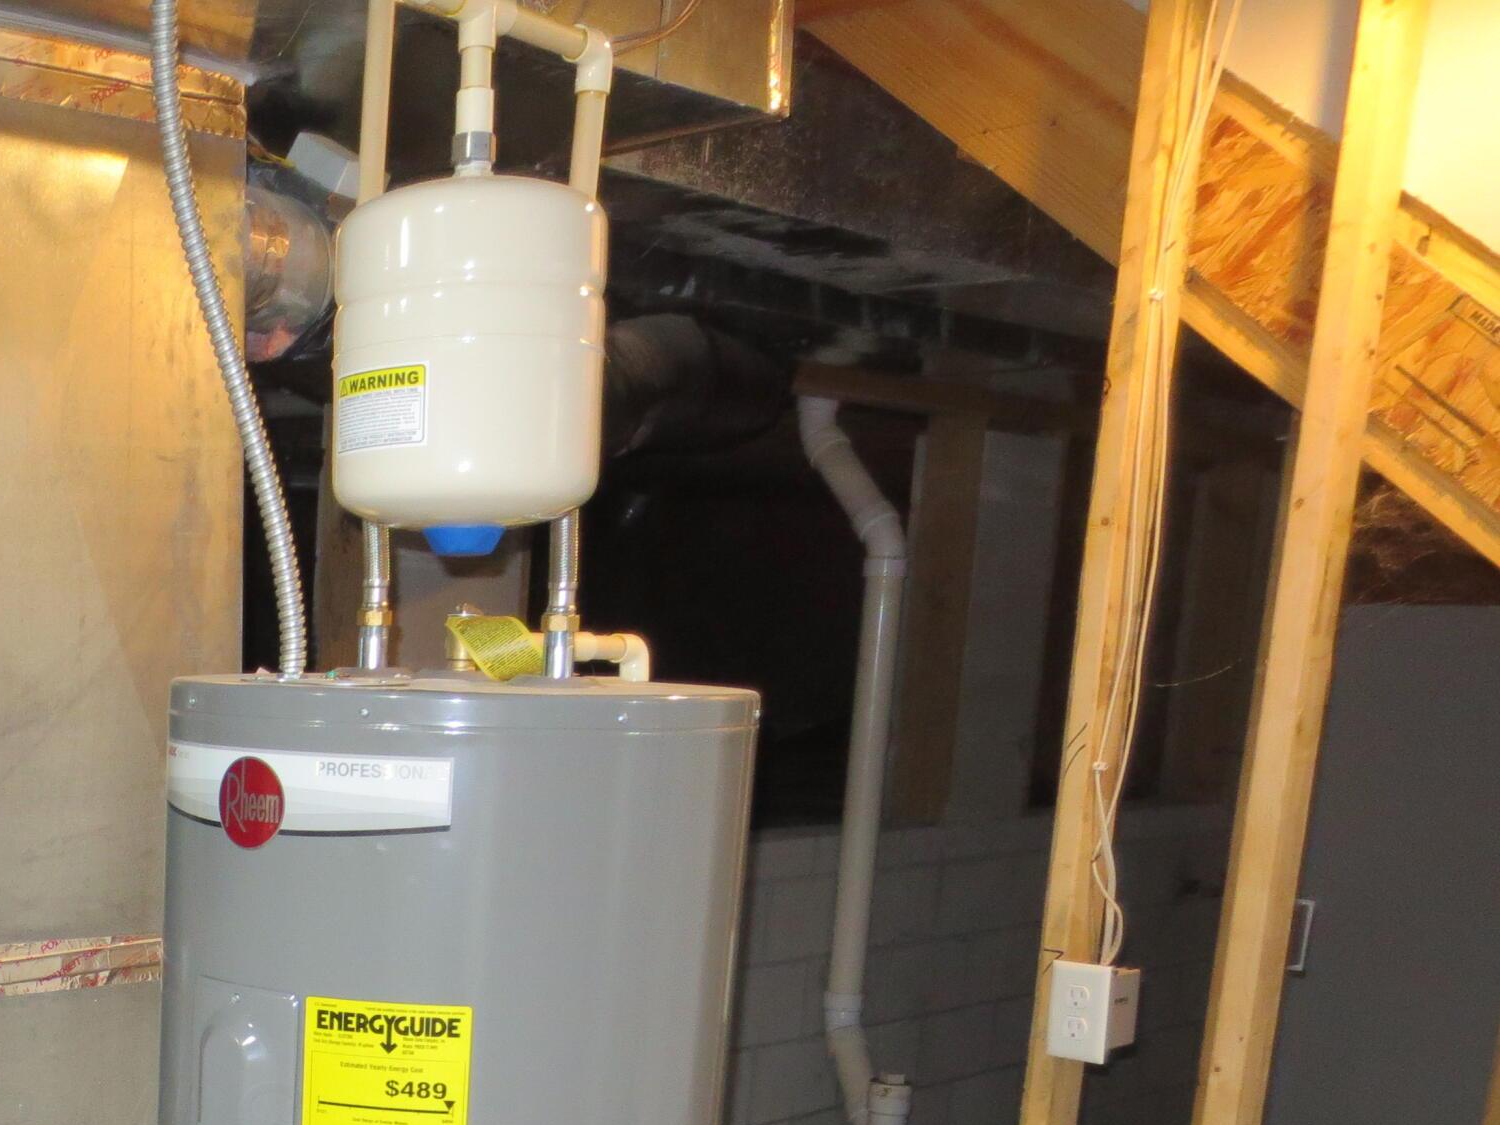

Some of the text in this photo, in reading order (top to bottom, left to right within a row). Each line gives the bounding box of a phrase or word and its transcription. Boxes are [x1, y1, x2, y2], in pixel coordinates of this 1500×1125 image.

[349, 370, 419, 394] WARNING
[317, 761, 446, 780] PROFESION
[224, 758, 280, 833] Rheem
[316, 1009, 461, 1039] ENERGYGUIDE
[385, 1079, 447, 1100] $489
